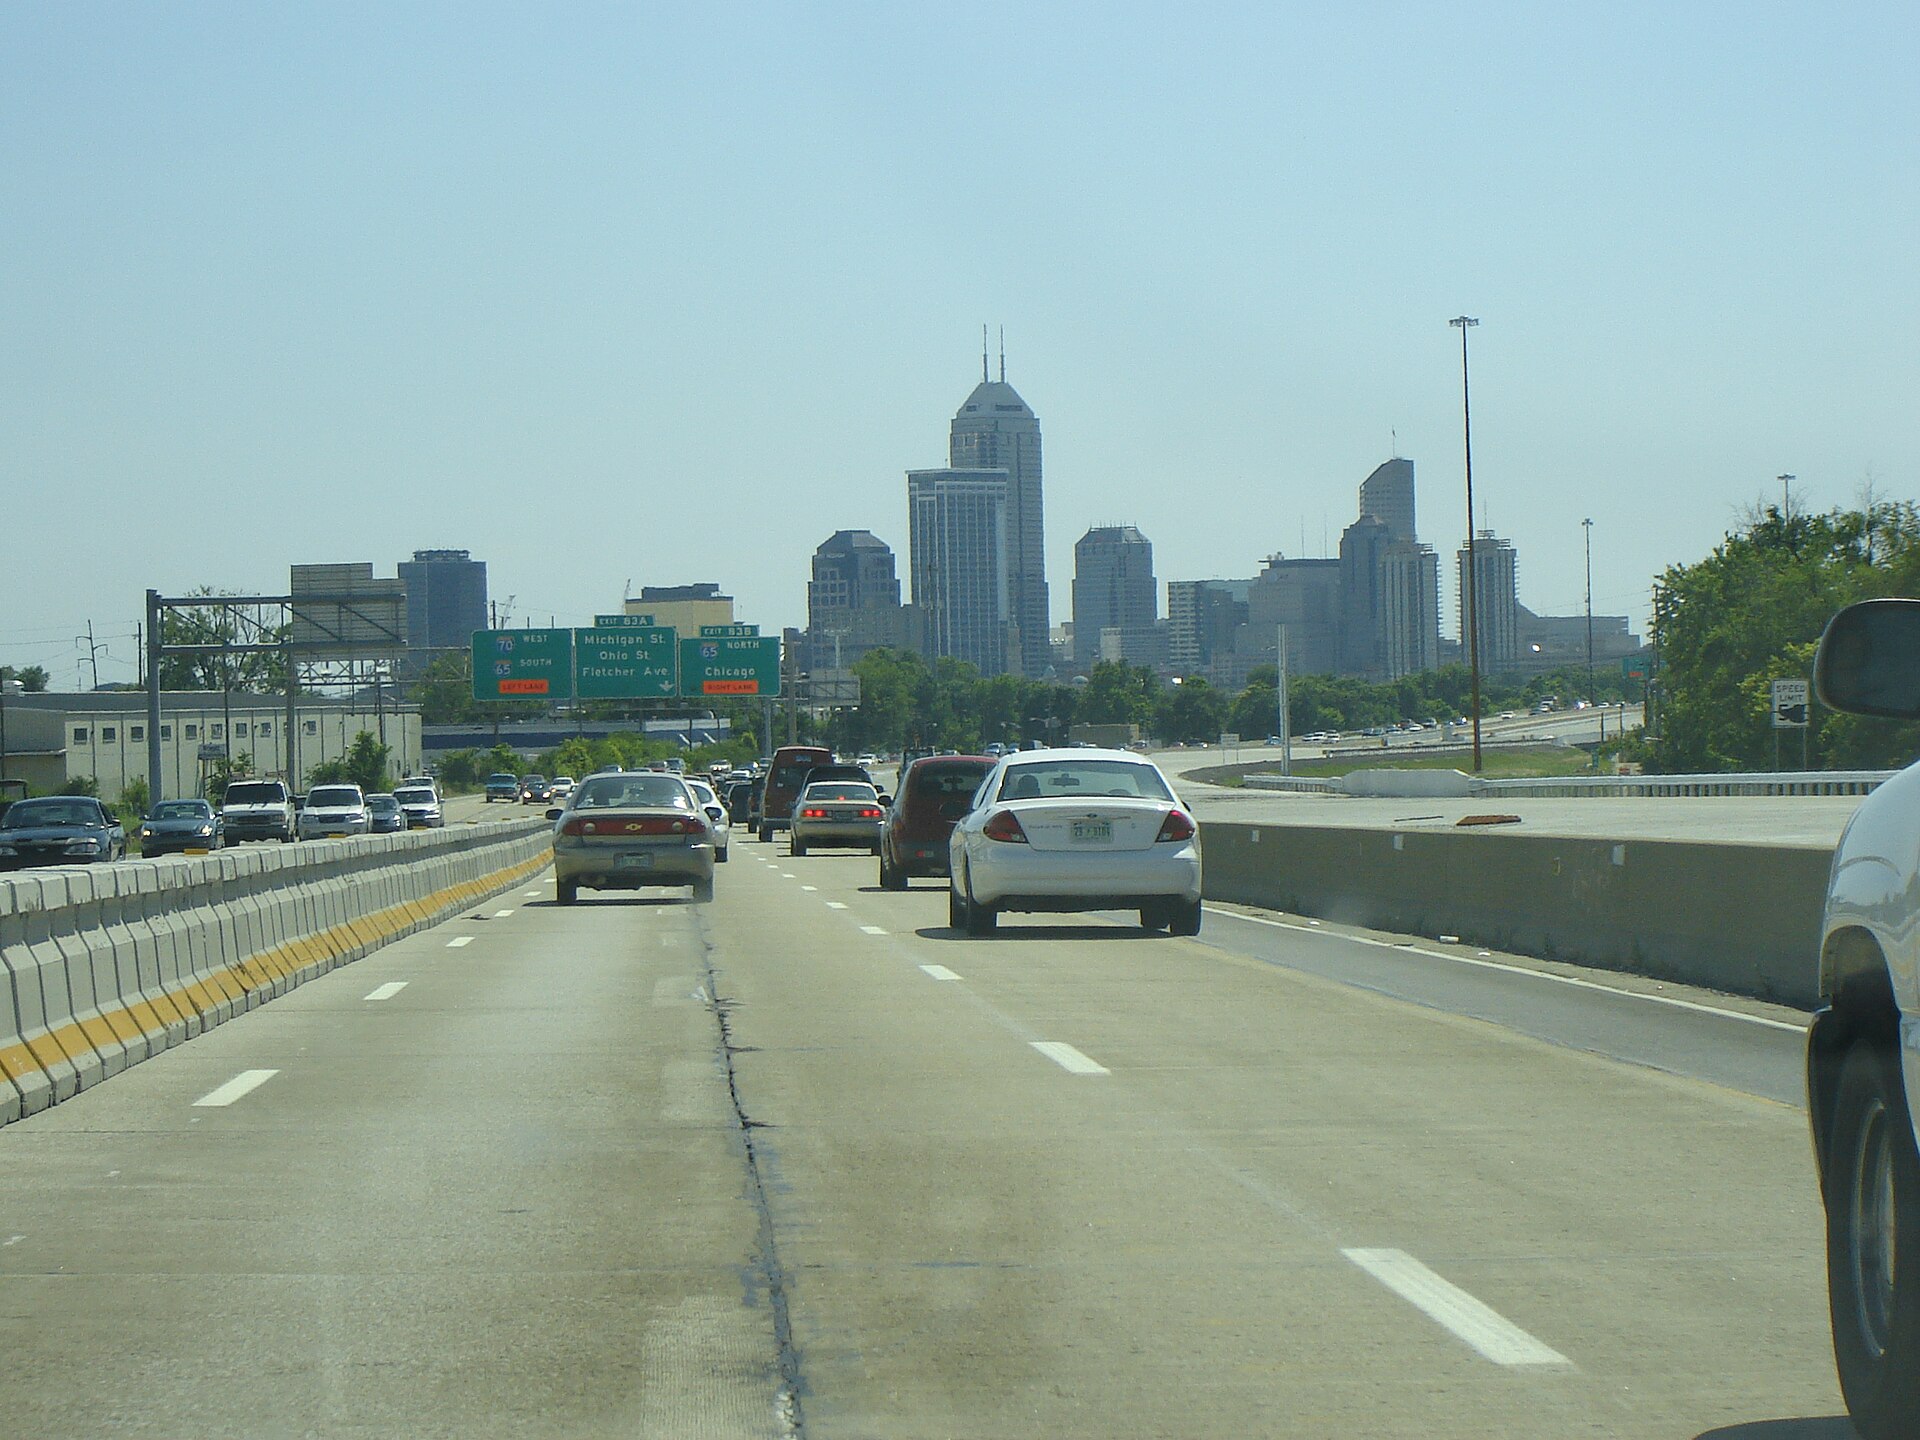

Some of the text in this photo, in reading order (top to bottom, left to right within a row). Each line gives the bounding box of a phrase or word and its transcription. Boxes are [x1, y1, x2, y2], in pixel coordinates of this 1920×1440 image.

[623, 616, 648, 625] 83A
[704, 627, 722, 635] EXIT
[522, 634, 548, 643] WEST
[584, 635, 643, 647] Michigan
[498, 640, 513, 651] 70
[727, 641, 760, 649] NORTH
[599, 650, 628, 661] Ohio
[702, 647, 718, 658] 65
[520, 658, 552, 667] SOUTH
[495, 663, 511, 675] 65
[582, 667, 636, 677] Fletcher
[704, 667, 756, 679] Chicago
[1776, 685, 1806, 693] SPEED
[1779, 694, 1804, 702] LIMIT
